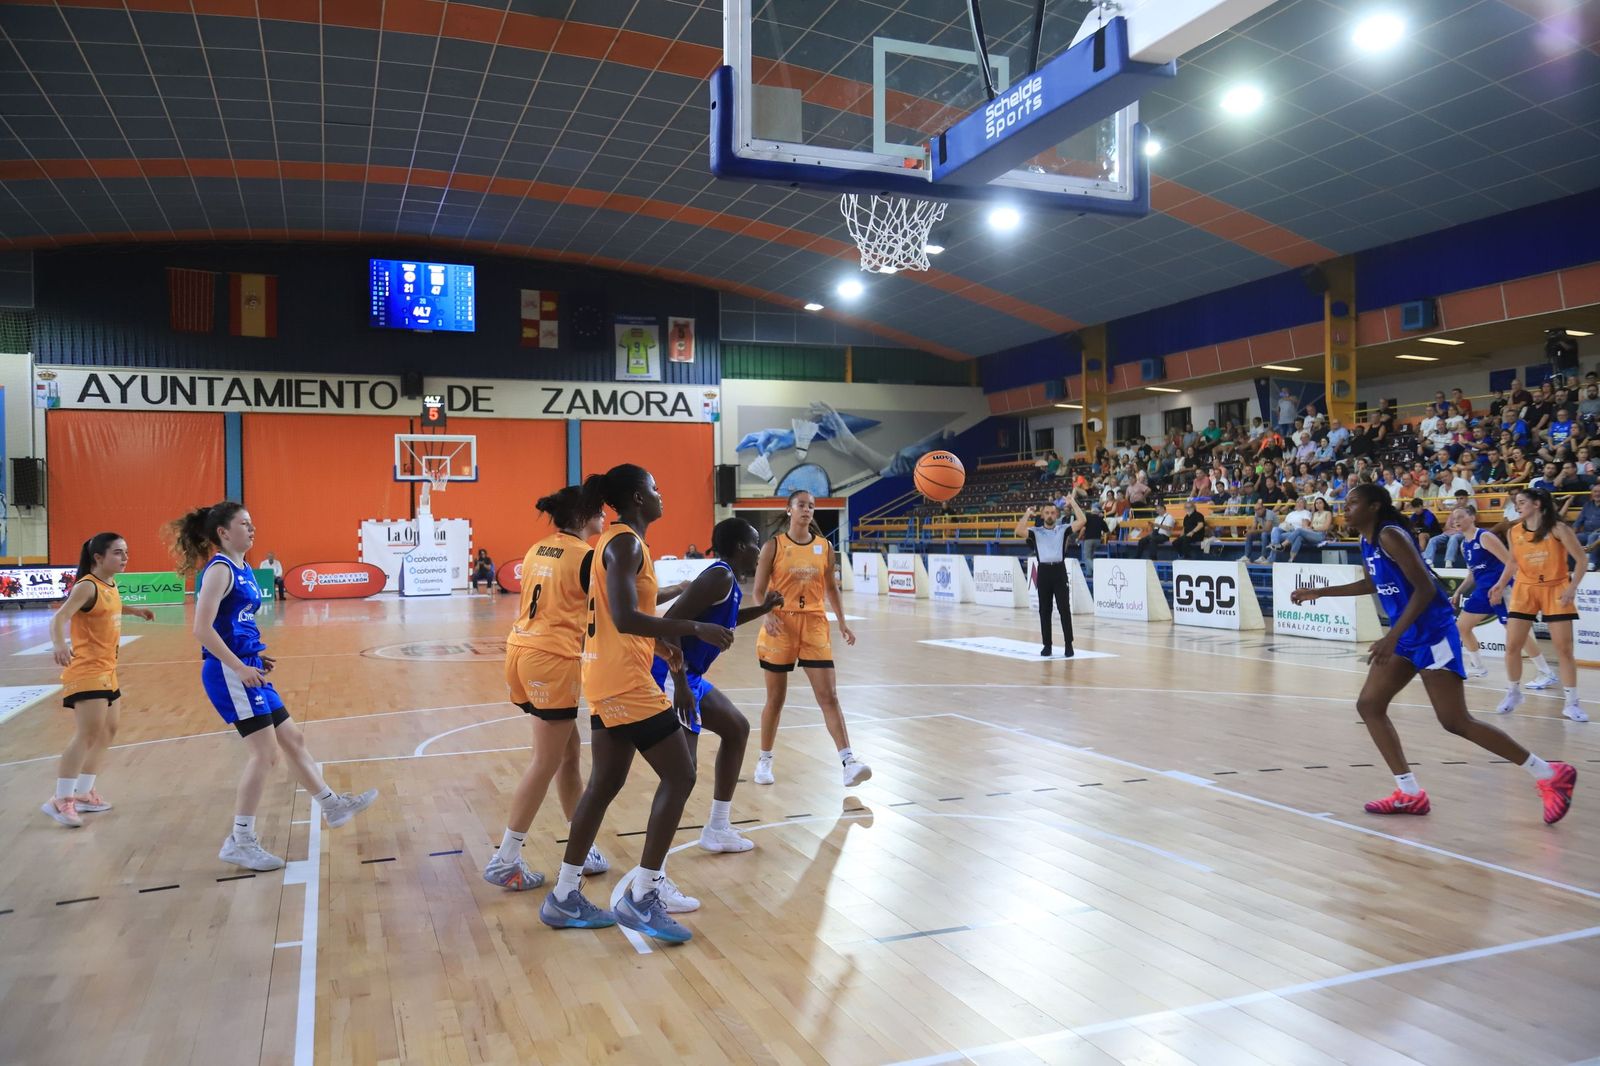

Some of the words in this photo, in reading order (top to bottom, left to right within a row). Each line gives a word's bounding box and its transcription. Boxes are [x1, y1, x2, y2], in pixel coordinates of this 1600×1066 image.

[986, 77, 1042, 123] Schelde
[986, 94, 1042, 139] Sports
[404, 283, 414, 293] 21
[77, 373, 399, 410] AYUNTAMIENTO
[447, 384, 494, 413] DE
[541, 387, 694, 417] ZAMORA
[428, 407, 439, 420] 5
[387, 527, 400, 542] La
[414, 555, 448, 563] cobreros
[117, 583, 182, 594] CUEVAS
[1175, 574, 1236, 614] G3C
[529, 584, 541, 619] 8
[799, 596, 806, 609] 5
[1096, 600, 1124, 609] recoletas
[1126, 600, 1143, 611] salud
[1277, 610, 1332, 625] HERBI-PLAST,
[1334, 615, 1350, 626] S.L.
[1277, 620, 1350, 635] SEÑALIZACIONES
